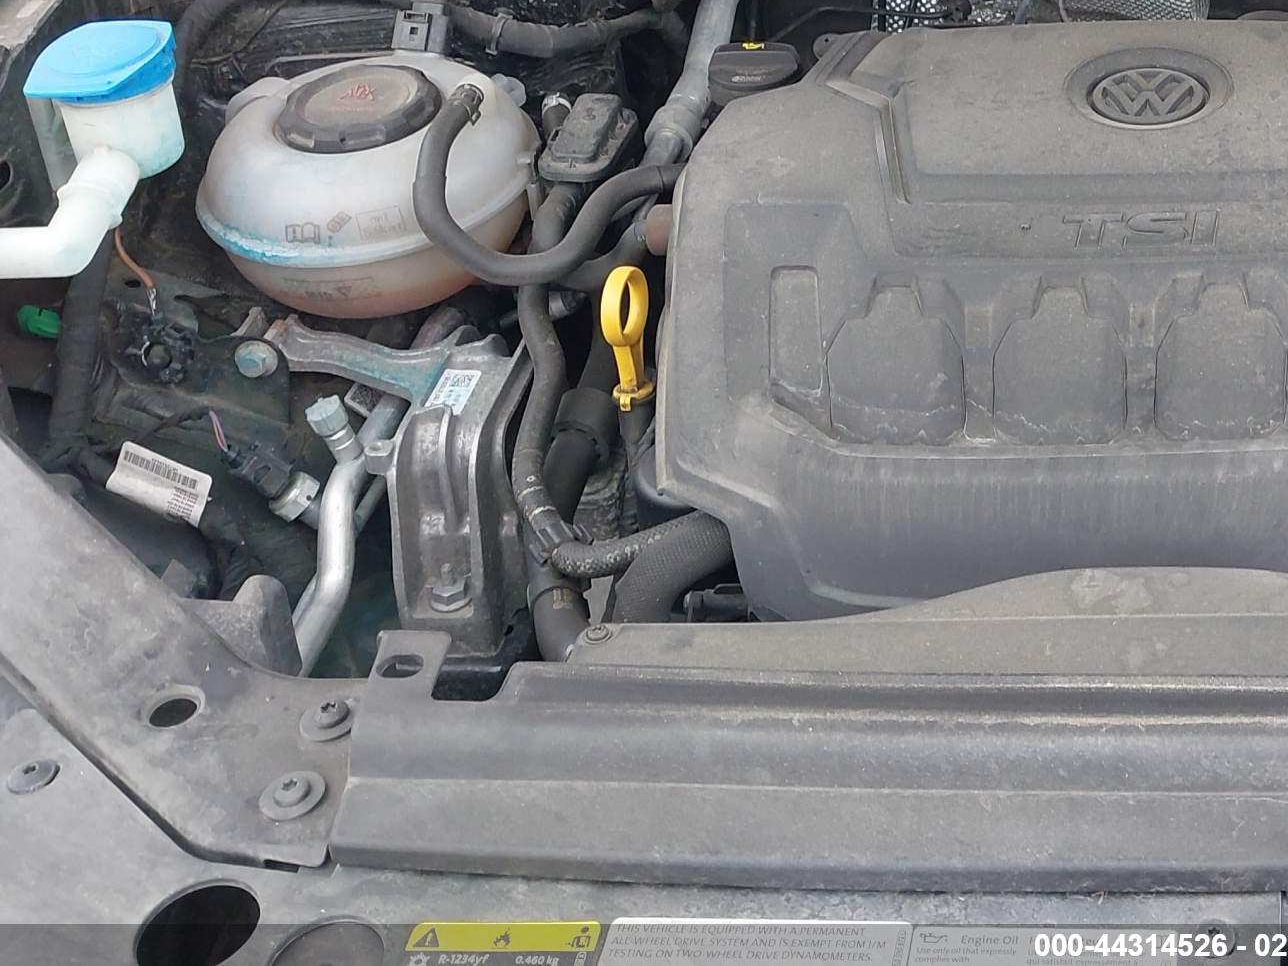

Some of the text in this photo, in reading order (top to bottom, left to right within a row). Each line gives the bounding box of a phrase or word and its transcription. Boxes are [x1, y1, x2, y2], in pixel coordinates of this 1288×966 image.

[1062, 210, 1220, 251] TSI
[616, 924, 640, 933] THIS
[643, 924, 685, 933] VEHICLE
[688, 925, 698, 934] IS
[702, 926, 756, 935] EQUIPPED
[759, 926, 787, 935] WITH
[800, 927, 866, 937] PERMANENT
[674, 937, 705, 946] DRIVE
[710, 938, 749, 946] SYSTEM
[751, 938, 776, 947] AND
[791, 939, 832, 948] EXEMPT
[836, 939, 865, 948] FROM
[960, 935, 1000, 947] Engine
[1002, 935, 1018, 945] Oil
[438, 954, 490, 966] R-1234yf
[515, 954, 544, 965] 0.460
[609, 949, 652, 958] TESTING
[656, 950, 674, 958] ON
[746, 951, 781, 960] DRIVE
